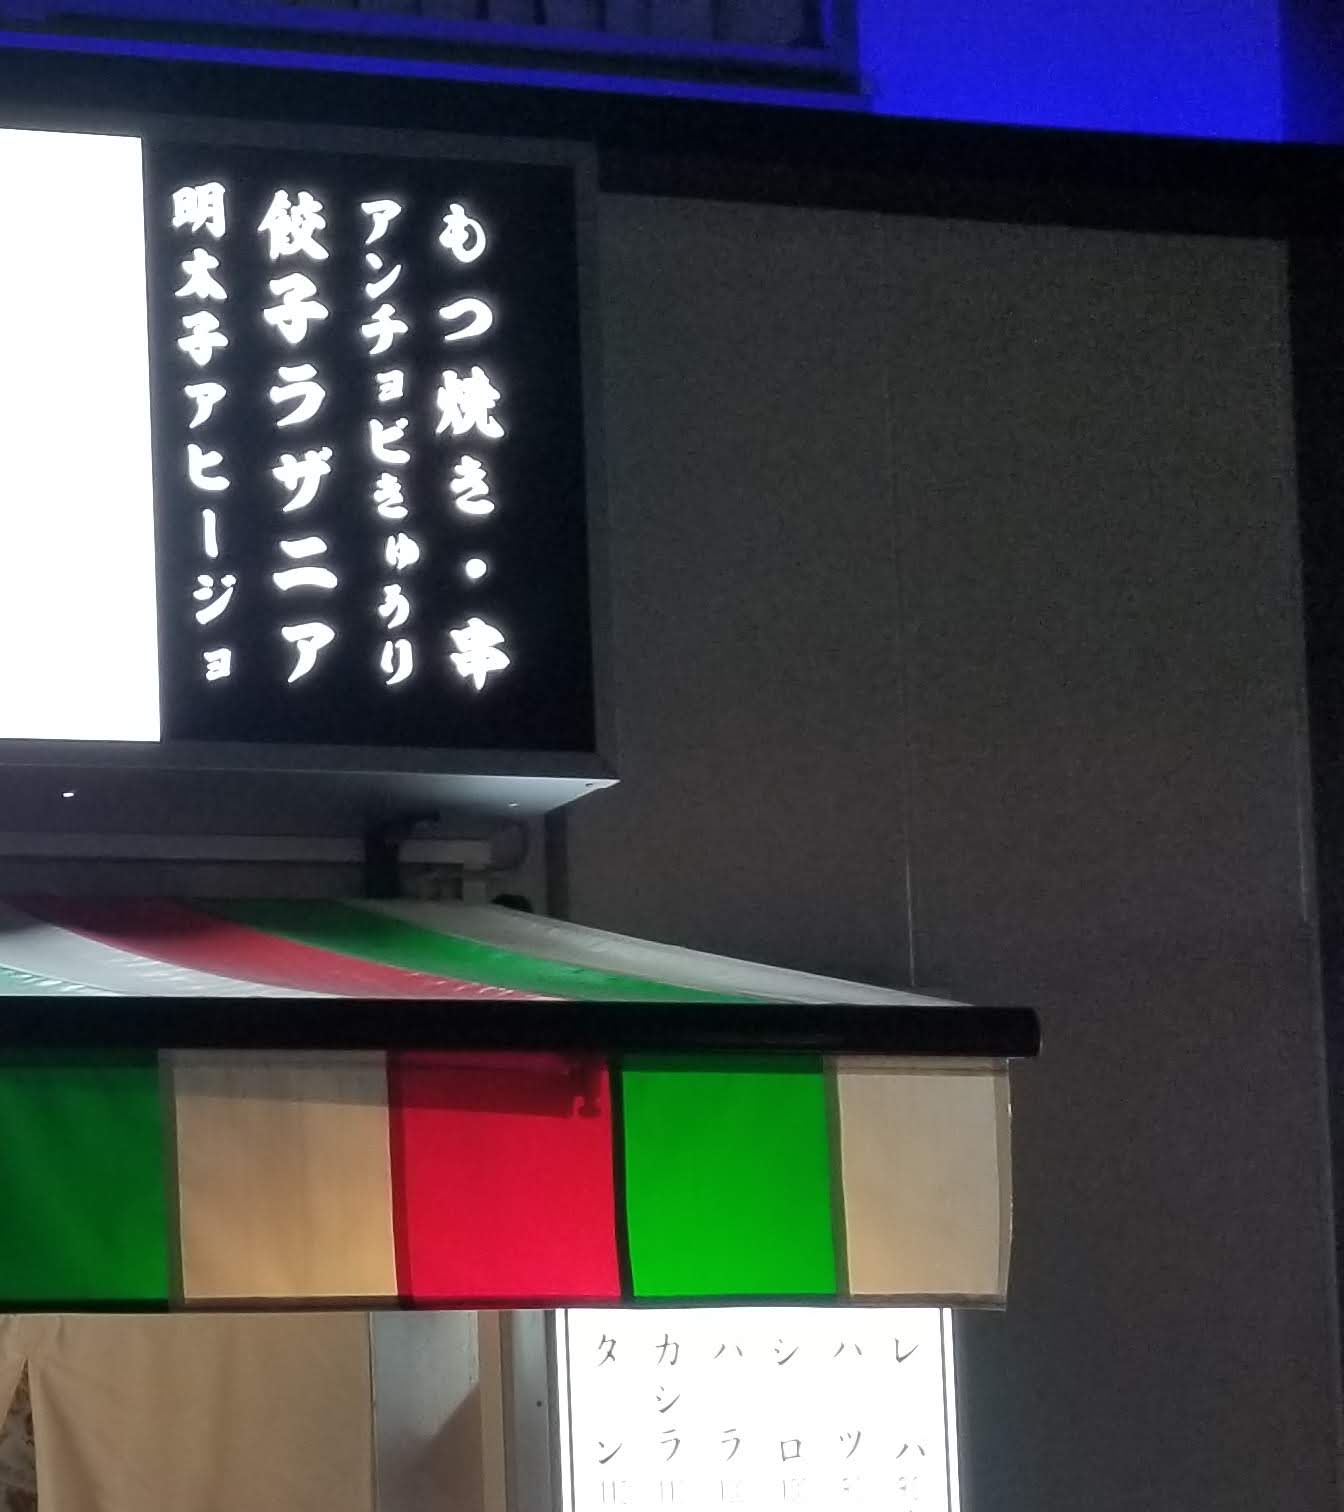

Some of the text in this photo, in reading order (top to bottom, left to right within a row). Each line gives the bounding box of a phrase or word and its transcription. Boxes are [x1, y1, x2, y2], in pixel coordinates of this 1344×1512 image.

[172, 182, 237, 682] 明太子アヒージョ
[258, 190, 338, 684] 餃子ラザニア
[361, 199, 420, 686] アンチョビきゅうり
